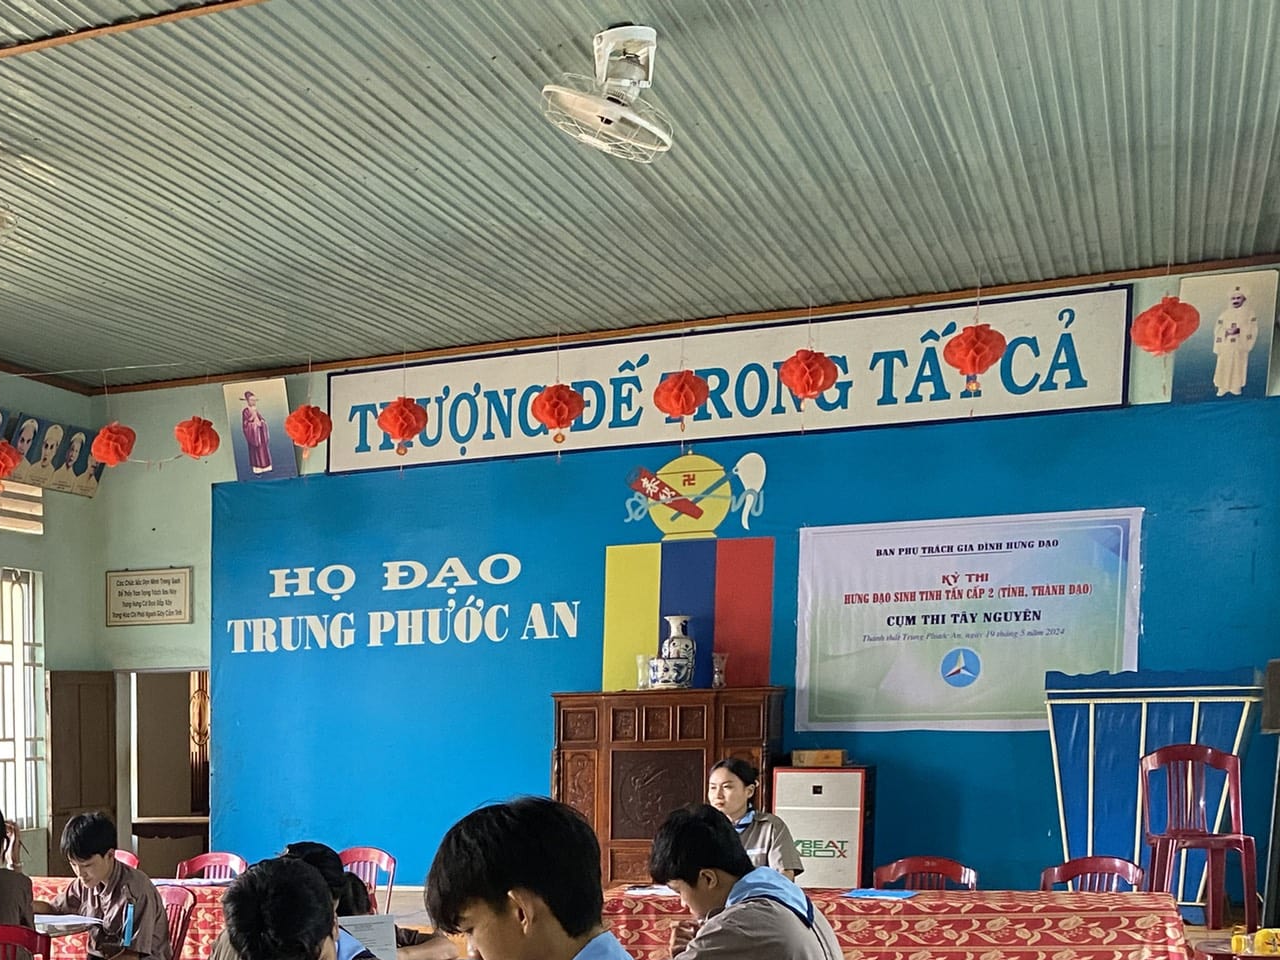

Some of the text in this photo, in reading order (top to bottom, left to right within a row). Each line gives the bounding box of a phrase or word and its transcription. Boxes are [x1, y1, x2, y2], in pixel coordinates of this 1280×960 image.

[348, 382, 551, 456] TƯỢNG
[660, 354, 853, 424] RONG
[869, 321, 983, 406] TẤ
[1000, 308, 1088, 396] CẢ
[876, 548, 895, 557] BAN
[957, 543, 974, 553] GIA
[268, 553, 522, 600] HỌ ĐẠO
[964, 572, 989, 583] THI
[893, 591, 916, 603] SINH
[919, 589, 942, 601] TINH
[966, 585, 985, 599] CẤP
[988, 587, 994, 598] 2
[227, 595, 581, 654] TRUNG PHƯỚC AN
[886, 609, 1042, 627] CỤM THI TÂY NGUYÊN
[1045, 627, 1065, 636] 2024
